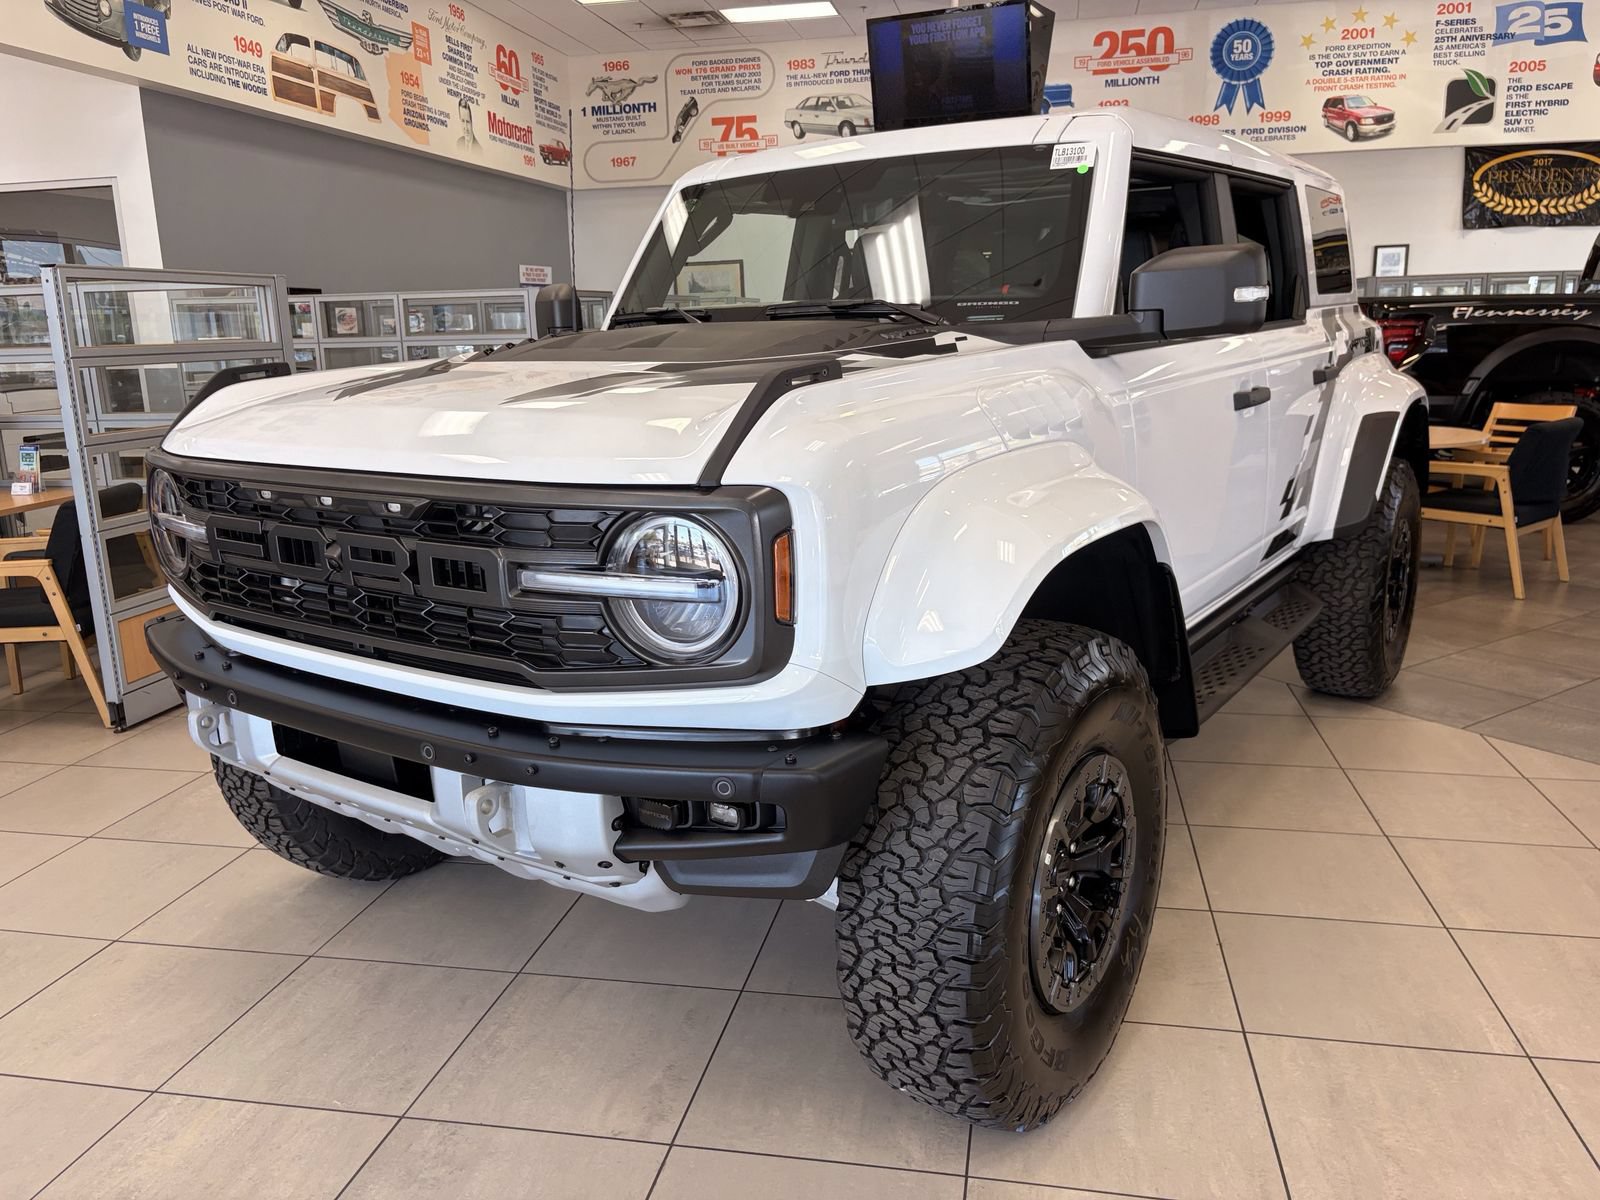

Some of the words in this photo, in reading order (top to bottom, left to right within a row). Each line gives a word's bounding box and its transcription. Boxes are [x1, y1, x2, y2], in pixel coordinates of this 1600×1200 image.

[213, 1, 228, 14] POST
[231, 8, 246, 20] WAR
[247, 13, 265, 27] FORD.
[428, 8, 443, 24] Ford
[448, 3, 465, 22] 1956
[1437, 3, 1472, 15] 2001
[134, 20, 138, 30] 1
[140, 22, 160, 36] PIECE
[911, 23, 926, 34] YOU
[927, 20, 951, 32] NEVER
[952, 16, 983, 31] FORGET
[1436, 18, 1476, 27] F-SERIES
[1508, 6, 1573, 36] 25
[1341, 27, 1375, 40] 2001
[1435, 26, 1484, 35] CELEBRATES
[1435, 35, 1457, 43] 25TH
[1459, 32, 1517, 42] ANIVERSARY
[446, 34, 459, 47] SELLS
[460, 42, 472, 53] FIRST
[909, 34, 928, 46] YOUR
[930, 31, 951, 43] FIRST
[234, 35, 262, 58] 1949
[448, 45, 465, 59] SHARES
[1092, 26, 1174, 76] 250
[1233, 39, 1252, 54] 50
[1445, 42, 1486, 50] AMERICA'S
[187, 43, 200, 54] ALL
[201, 48, 216, 60] NEW
[218, 53, 251, 69] POST-WAR
[252, 64, 266, 75] ERA
[442, 52, 463, 67] COMMON
[531, 52, 544, 66] 1965
[1230, 53, 1254, 61] YEARS
[1336, 57, 1400, 67] GOVERNMENT
[188, 55, 208, 69] CARS
[209, 62, 222, 72] ARE
[224, 65, 267, 85] INTRODUCED
[496, 44, 520, 95] 60
[602, 60, 630, 72] 1966
[787, 59, 815, 70] 1983
[1509, 60, 1546, 73] 2005
[1322, 69, 1353, 77] CRASH
[1355, 67, 1390, 75] RATING.
[189, 67, 226, 84] INCLUDING
[227, 77, 241, 88] THE
[242, 81, 268, 96] WOODIE
[400, 71, 420, 89] 1954
[1105, 76, 1160, 88] MILLIONTH
[1536, 82, 1573, 91] ESCAPE
[401, 89, 412, 99] FORD
[446, 87, 462, 99] HENRY
[402, 98, 416, 109] CRASH
[417, 103, 433, 114] TESTING
[501, 94, 519, 108] MILLION
[1535, 99, 1569, 107] HYBRID
[581, 107, 586, 117] 1
[591, 102, 656, 116] MILLIONTH
[1259, 110, 1291, 123] 1999
[1505, 109, 1549, 117] ELECTRIC
[403, 108, 426, 121] ARIZONA
[427, 114, 448, 128] PROVING
[404, 118, 431, 132] GROUNDS.
[1188, 115, 1220, 126] 1998
[488, 111, 534, 146] Motorcraft
[712, 115, 759, 156] 75
[1241, 126, 1265, 135] FORD
[1268, 126, 1306, 134] DIVISION
[524, 154, 536, 167] 1961
[610, 156, 636, 167] 1967
[1510, 181, 1573, 196] AWARD
[1452, 306, 1592, 320] Hennessey
[206, 512, 504, 606] FORD
